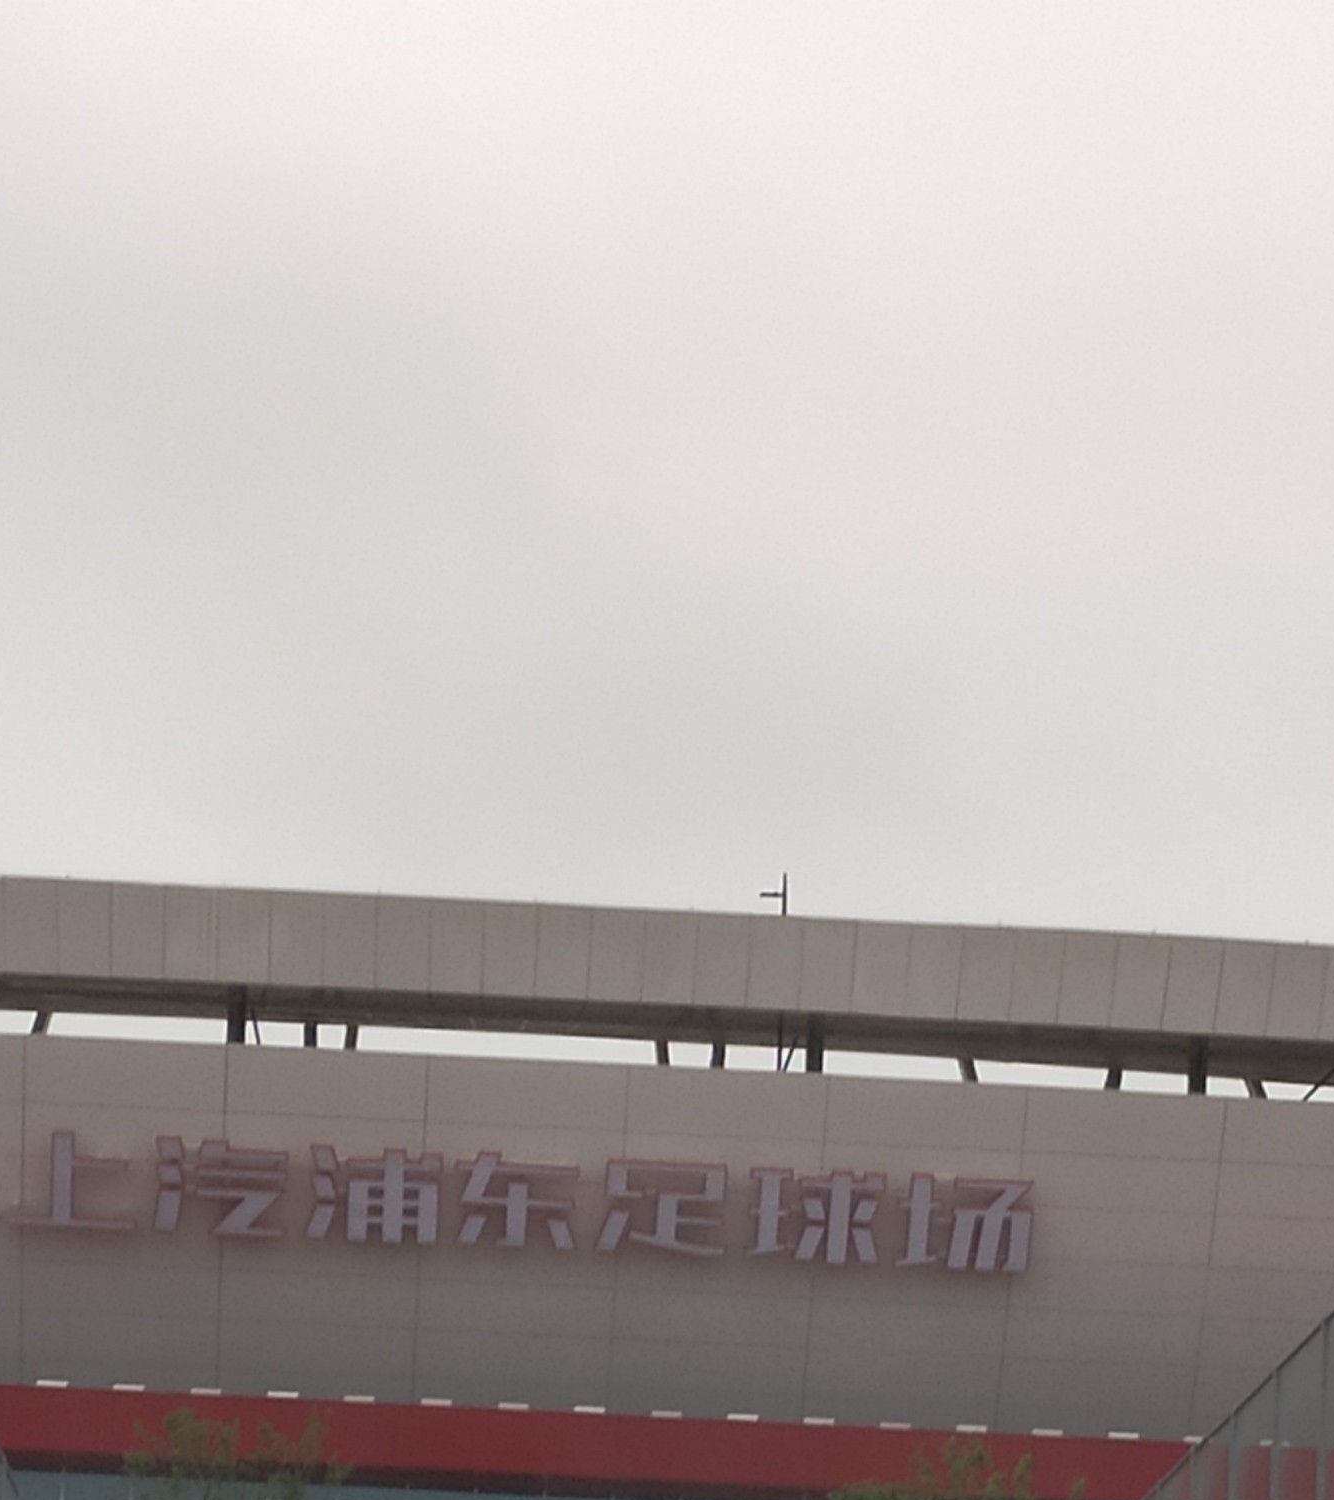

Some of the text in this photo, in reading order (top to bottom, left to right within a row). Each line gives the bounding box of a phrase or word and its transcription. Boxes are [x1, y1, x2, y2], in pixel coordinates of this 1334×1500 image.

[1, 1130, 1035, 1272] 上汽浦东足球场
